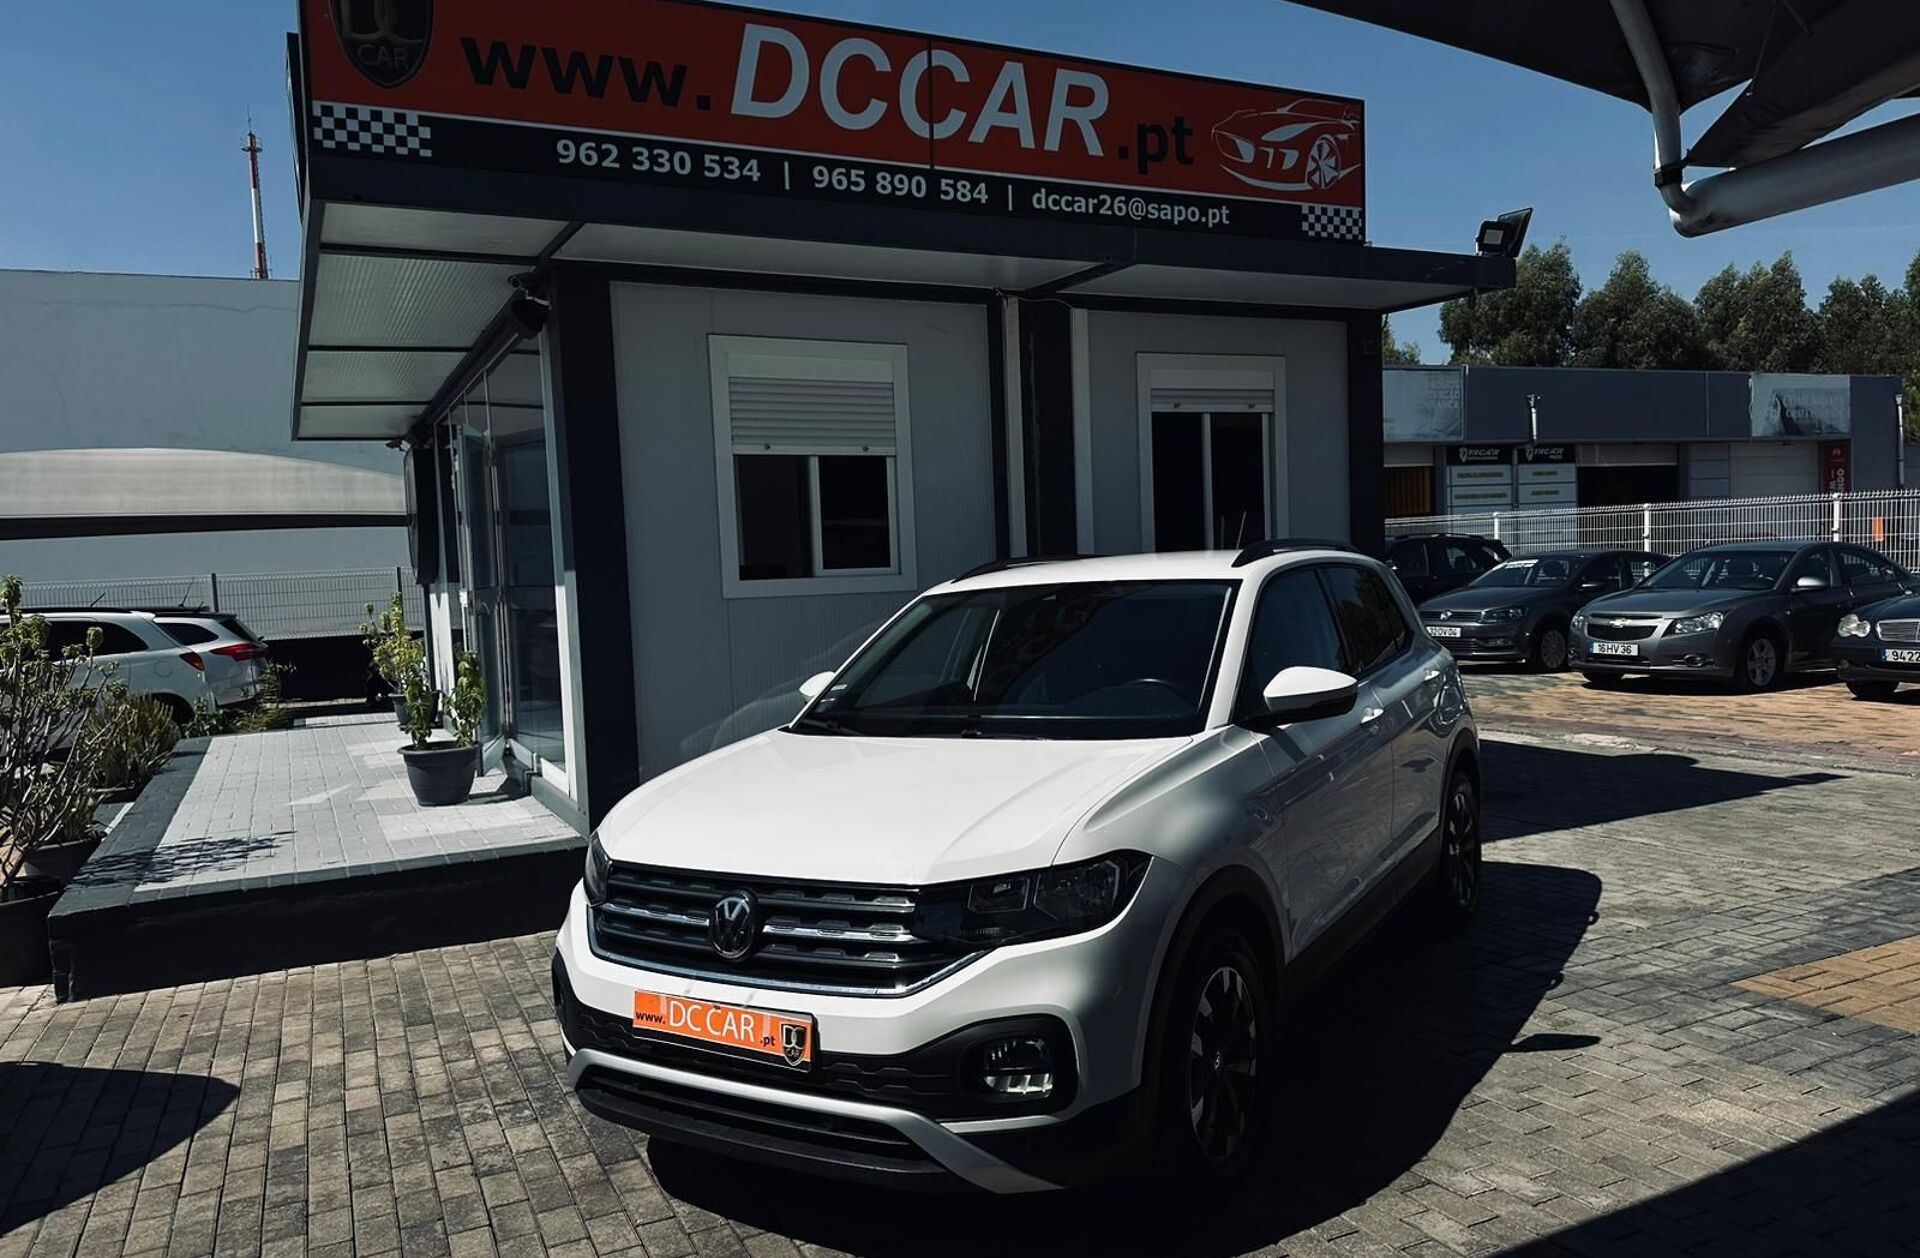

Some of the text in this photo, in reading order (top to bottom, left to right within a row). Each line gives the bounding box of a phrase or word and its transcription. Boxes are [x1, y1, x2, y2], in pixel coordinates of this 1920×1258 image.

[357, 44, 411, 72] CAR
[556, 138, 620, 169] 962
[631, 146, 693, 176] 330
[703, 154, 761, 183] 534
[812, 165, 866, 193] 965
[875, 171, 927, 199] 890
[940, 178, 988, 205] 584
[1031, 187, 1230, 228] dccar26@sapo.pt
